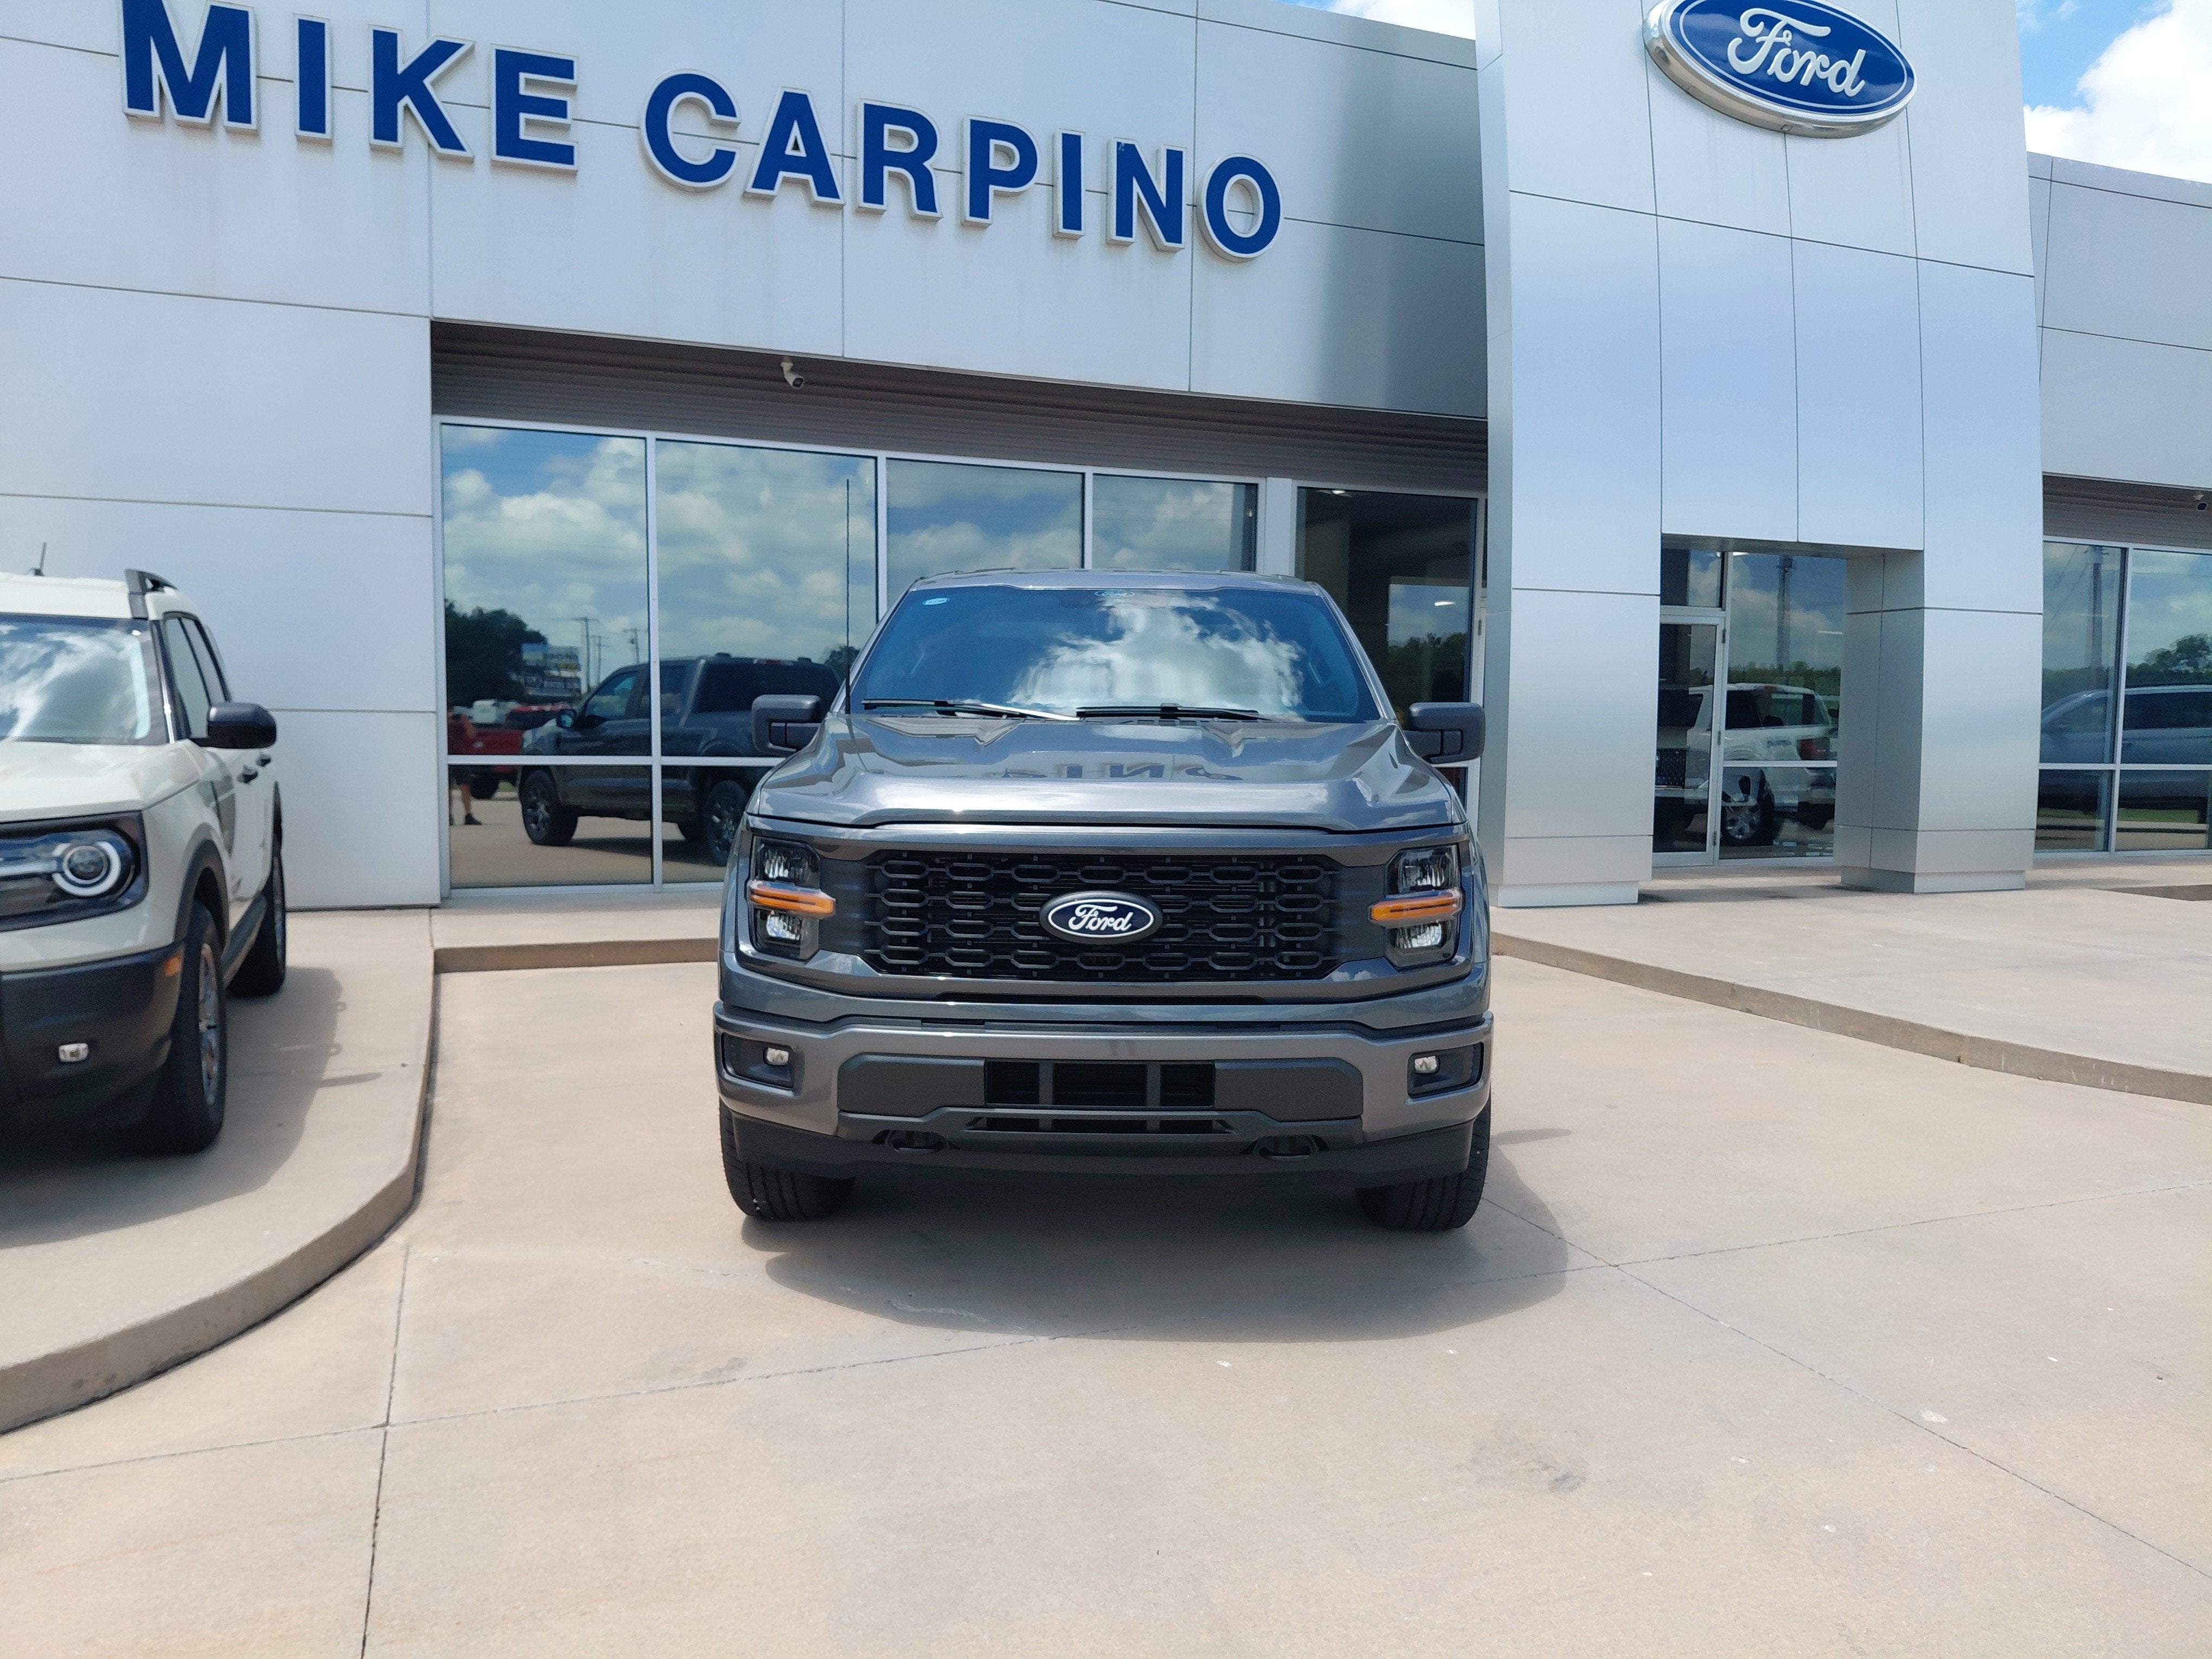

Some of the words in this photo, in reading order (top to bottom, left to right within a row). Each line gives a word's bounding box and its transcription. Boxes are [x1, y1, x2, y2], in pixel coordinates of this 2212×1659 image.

[1727, 8, 1867, 98] Ford
[121, 0, 576, 167] MIKE
[643, 72, 1282, 257] CARPINO
[1068, 904, 1134, 931] Ford
